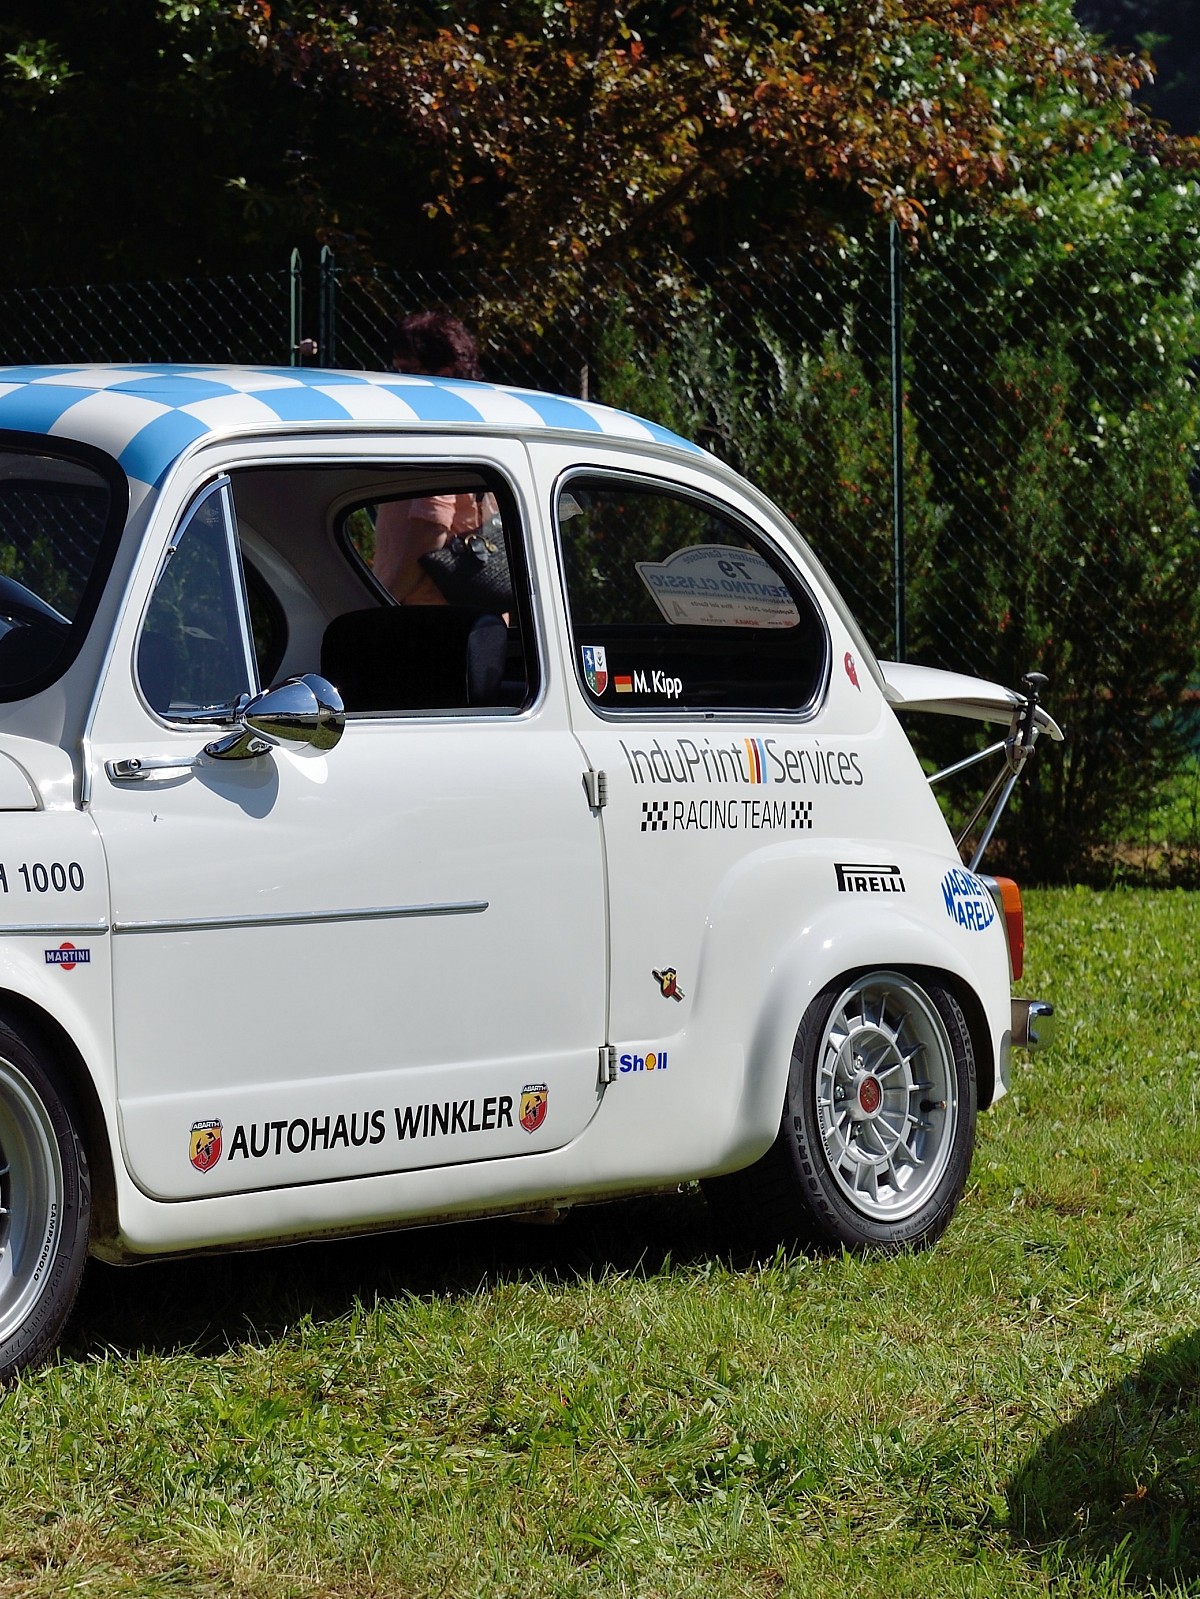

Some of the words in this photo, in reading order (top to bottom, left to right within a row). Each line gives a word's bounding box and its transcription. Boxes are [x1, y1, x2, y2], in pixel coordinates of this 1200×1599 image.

[652, 670, 682, 699] Kipp
[619, 738, 750, 784] InduPrint
[764, 739, 863, 785] Services
[673, 800, 738, 830] RACING
[742, 800, 787, 829] TEAM
[17, 861, 85, 893] 1000
[833, 863, 906, 892] PIRELLI
[46, 950, 89, 963] MARTINI
[620, 1052, 668, 1073] Shll
[522, 1083, 546, 1093] ABARTH
[192, 1120, 221, 1130] ABARTH
[227, 1109, 386, 1161] AUTOHAUS
[394, 1095, 514, 1141] WINKLER
[33, 1203, 57, 1282] CAMPAGNOLO
